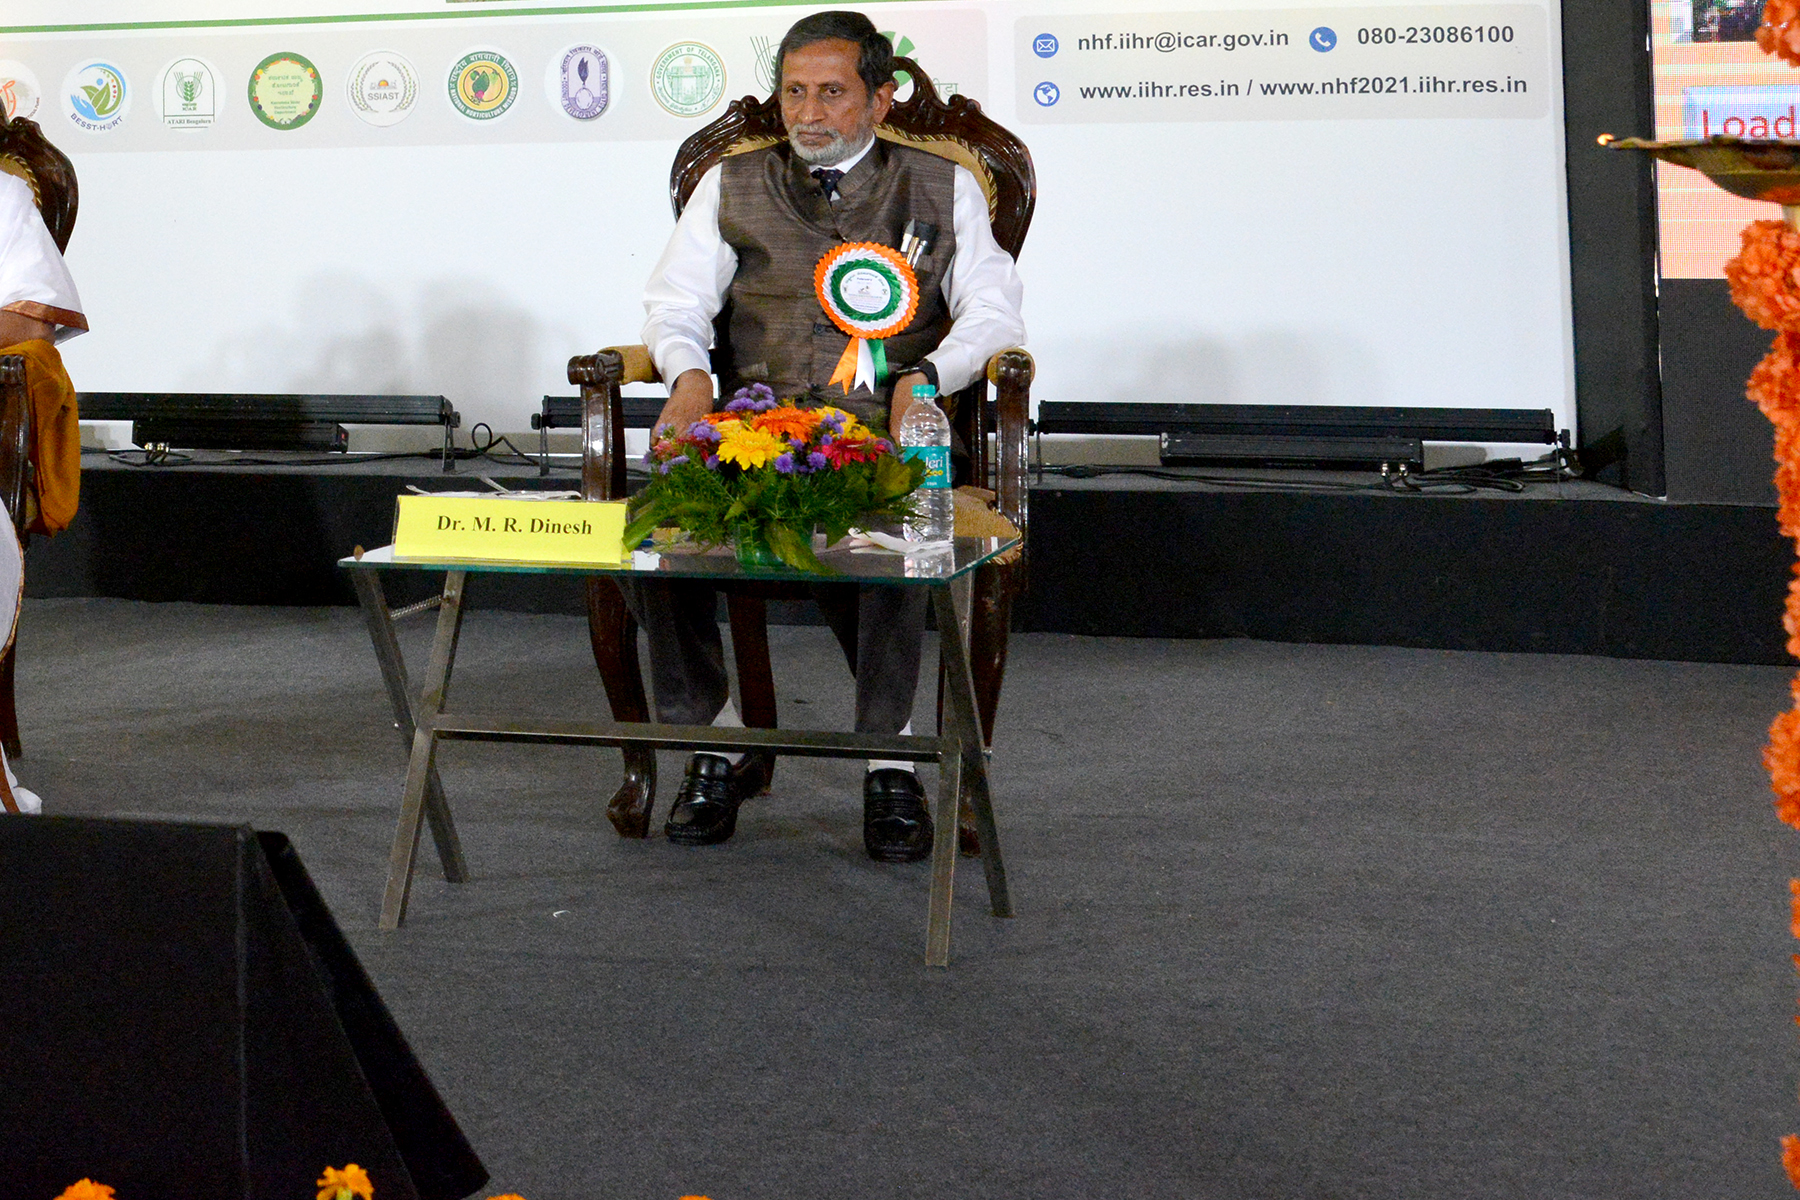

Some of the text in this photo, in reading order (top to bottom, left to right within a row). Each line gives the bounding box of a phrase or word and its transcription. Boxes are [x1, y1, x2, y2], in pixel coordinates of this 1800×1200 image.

[1078, 25, 1514, 53] nhf.iihr@icar.gov.in 080-23086100
[656, 48, 683, 80] GOVERNMENT
[698, 48, 722, 78] TELANGANA
[1080, 80, 1240, 99] www.iihr.res.in
[1260, 76, 1527, 96] www.nhf2021.iihr.res.in
[1702, 105, 1796, 138] Load
[437, 515, 592, 535] Dr. M. R. Dinesh
